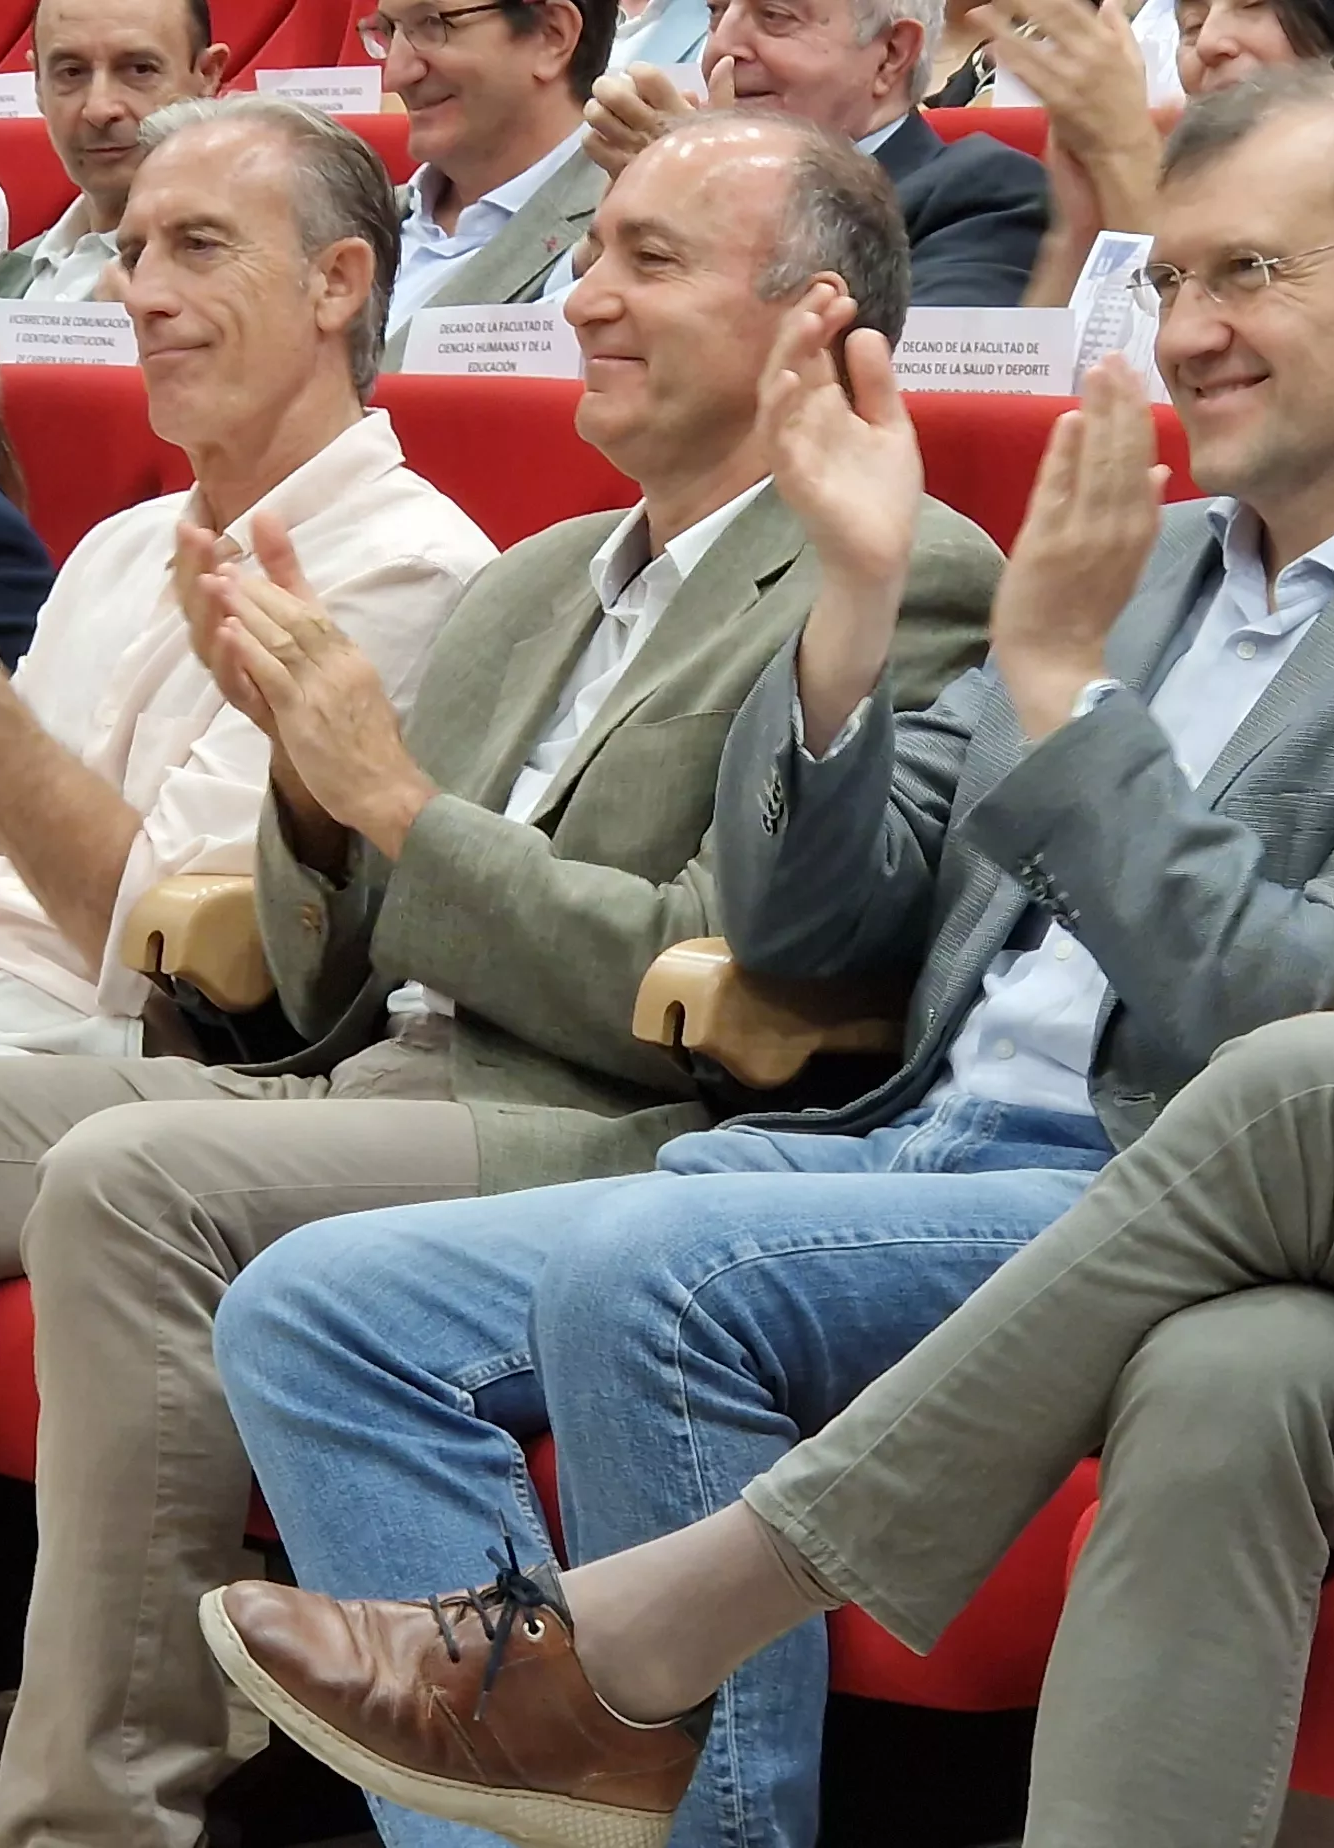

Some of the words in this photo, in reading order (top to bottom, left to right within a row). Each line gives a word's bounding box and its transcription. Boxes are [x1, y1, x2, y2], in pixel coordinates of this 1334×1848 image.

[9, 314, 60, 326] VICERRECTORA
[62, 316, 71, 327] DE
[440, 323, 473, 335] DECANO
[475, 322, 485, 333] DE
[488, 322, 498, 333] LA
[499, 321, 540, 333] FACULTAD
[543, 320, 554, 331] DE
[22, 333, 61, 344] IDENTIDAD
[61, 335, 116, 347] INSTITUCIONAL
[438, 342, 475, 354] CIENCIAS
[477, 342, 520, 353] HUMANAS
[521, 341, 527, 352] Y
[529, 341, 540, 352] DE
[542, 341, 551, 351] LA
[903, 341, 943, 353] DECANO
[945, 341, 958, 353] DE
[960, 342, 972, 353] LA
[974, 341, 1024, 354] FACULTAD
[1026, 342, 1039, 354] DE
[468, 361, 517, 373] EDUCACIÓN
[934, 362, 947, 374] DE
[949, 363, 960, 374] LA
[962, 363, 995, 375] SALUD
[997, 364, 1003, 375] Y
[1005, 364, 1050, 376] DEPORTE
